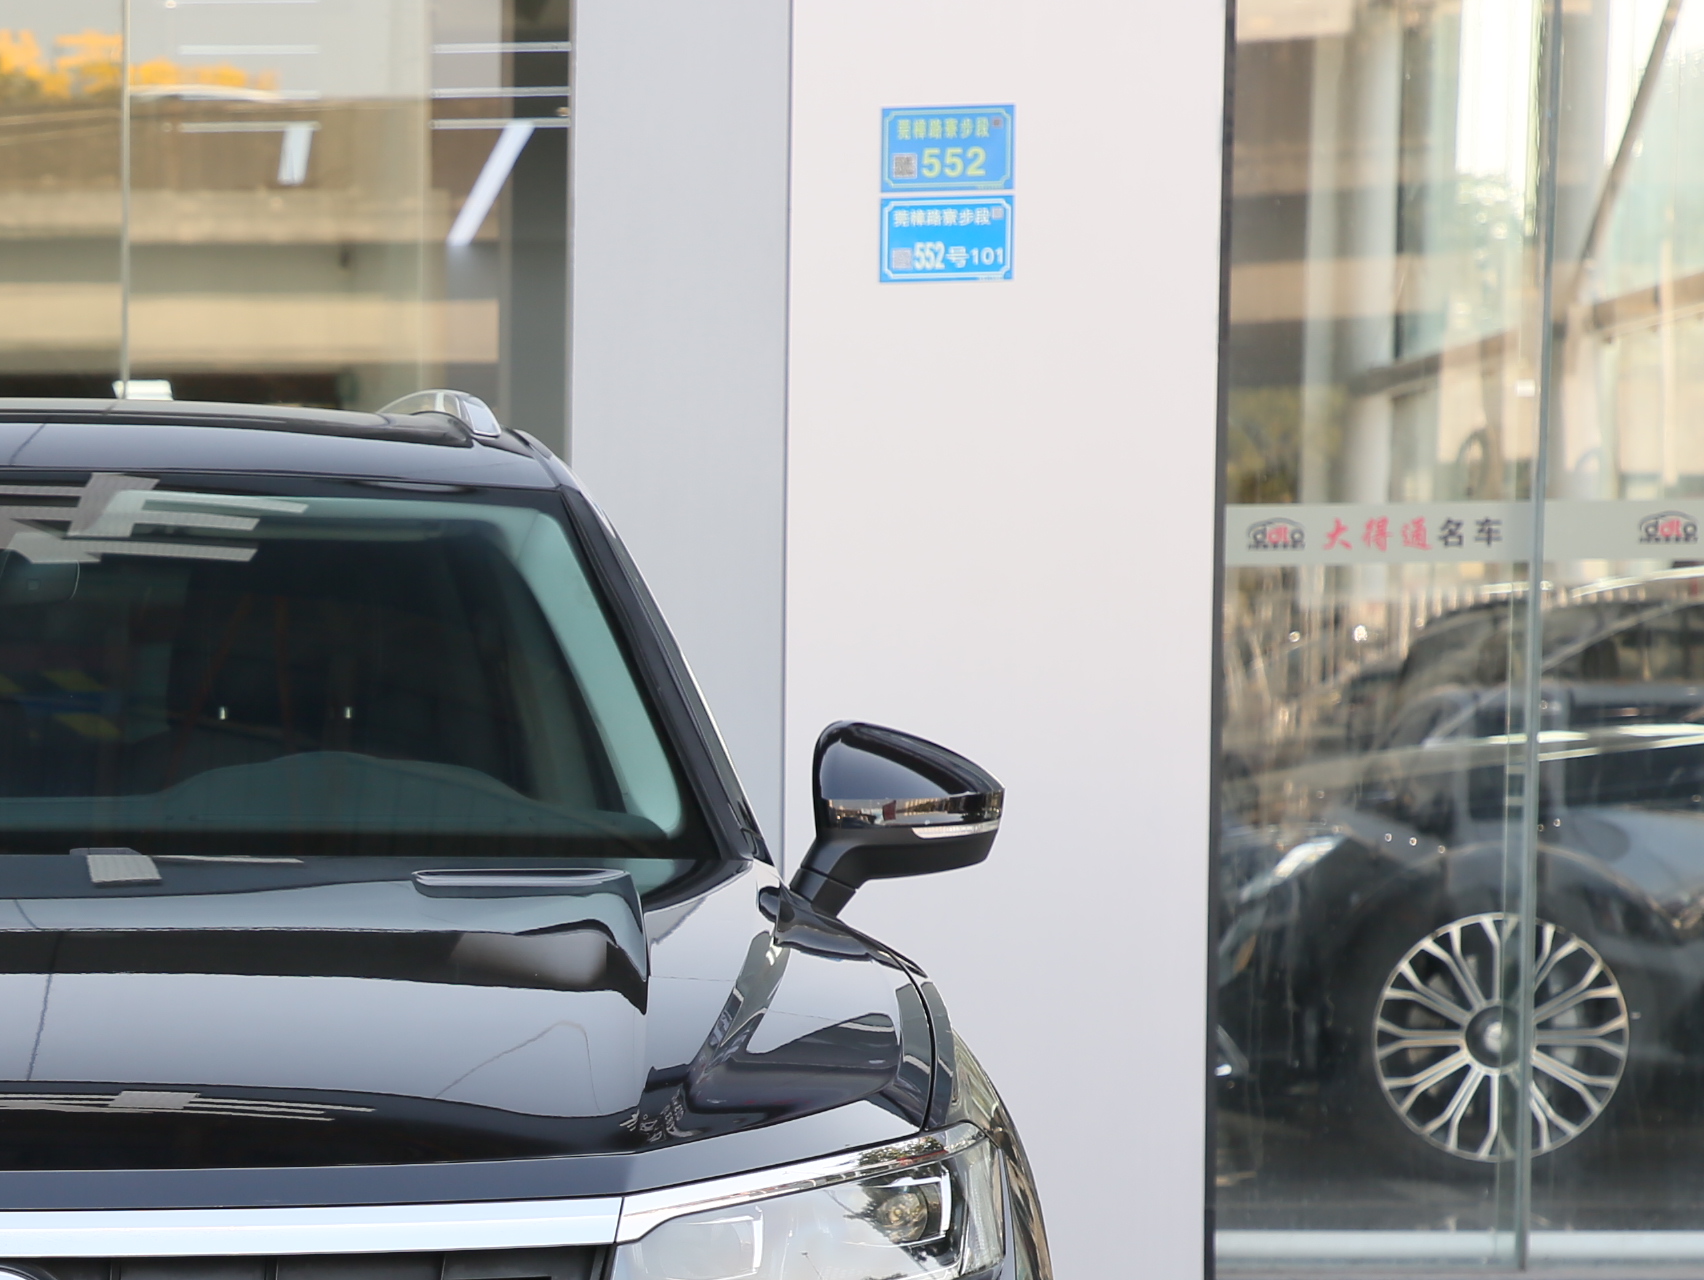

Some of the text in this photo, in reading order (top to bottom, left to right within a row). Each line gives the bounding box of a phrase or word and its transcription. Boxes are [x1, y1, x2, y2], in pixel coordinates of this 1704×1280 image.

[922, 146, 987, 178] 552
[1323, 515, 1504, 552] 大得通名车
